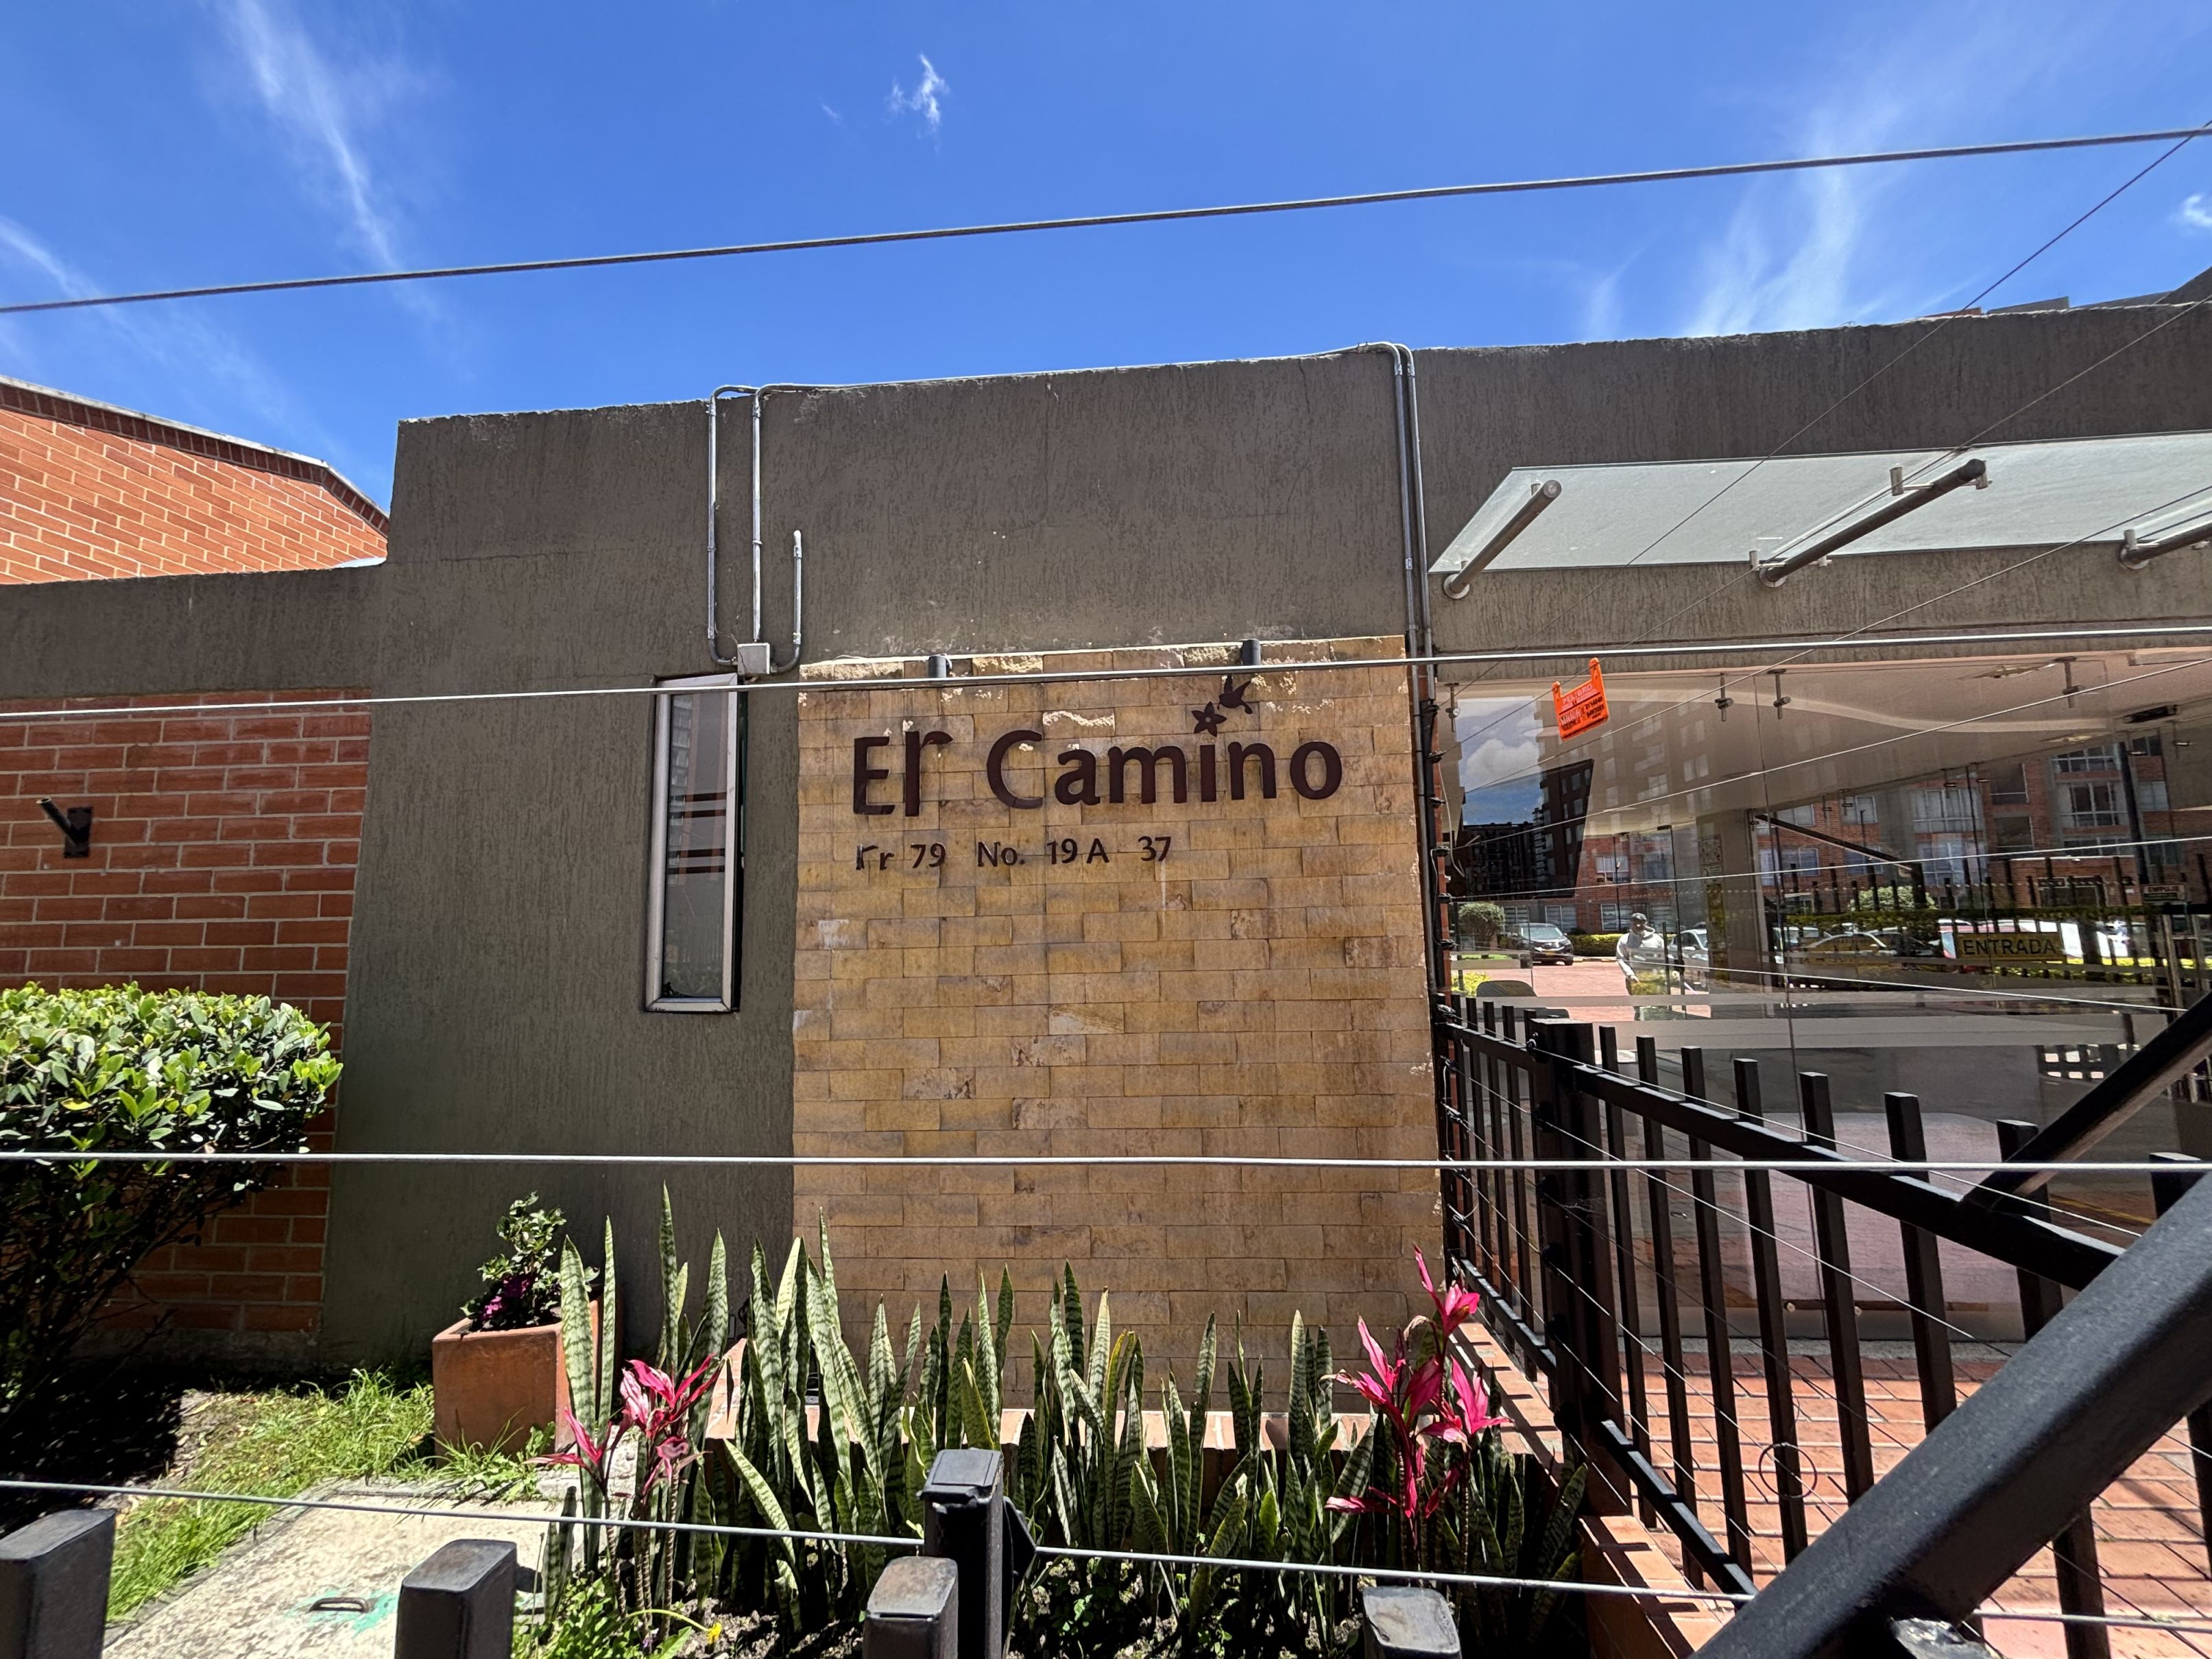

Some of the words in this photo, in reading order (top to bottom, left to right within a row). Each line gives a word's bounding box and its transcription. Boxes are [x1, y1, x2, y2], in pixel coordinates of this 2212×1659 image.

[986, 728, 1343, 810] Camino
[910, 842, 946, 869] 79
[977, 841, 1026, 868] No.
[1138, 835, 1171, 862] 37
[1962, 938, 2057, 955] ENTRADA
